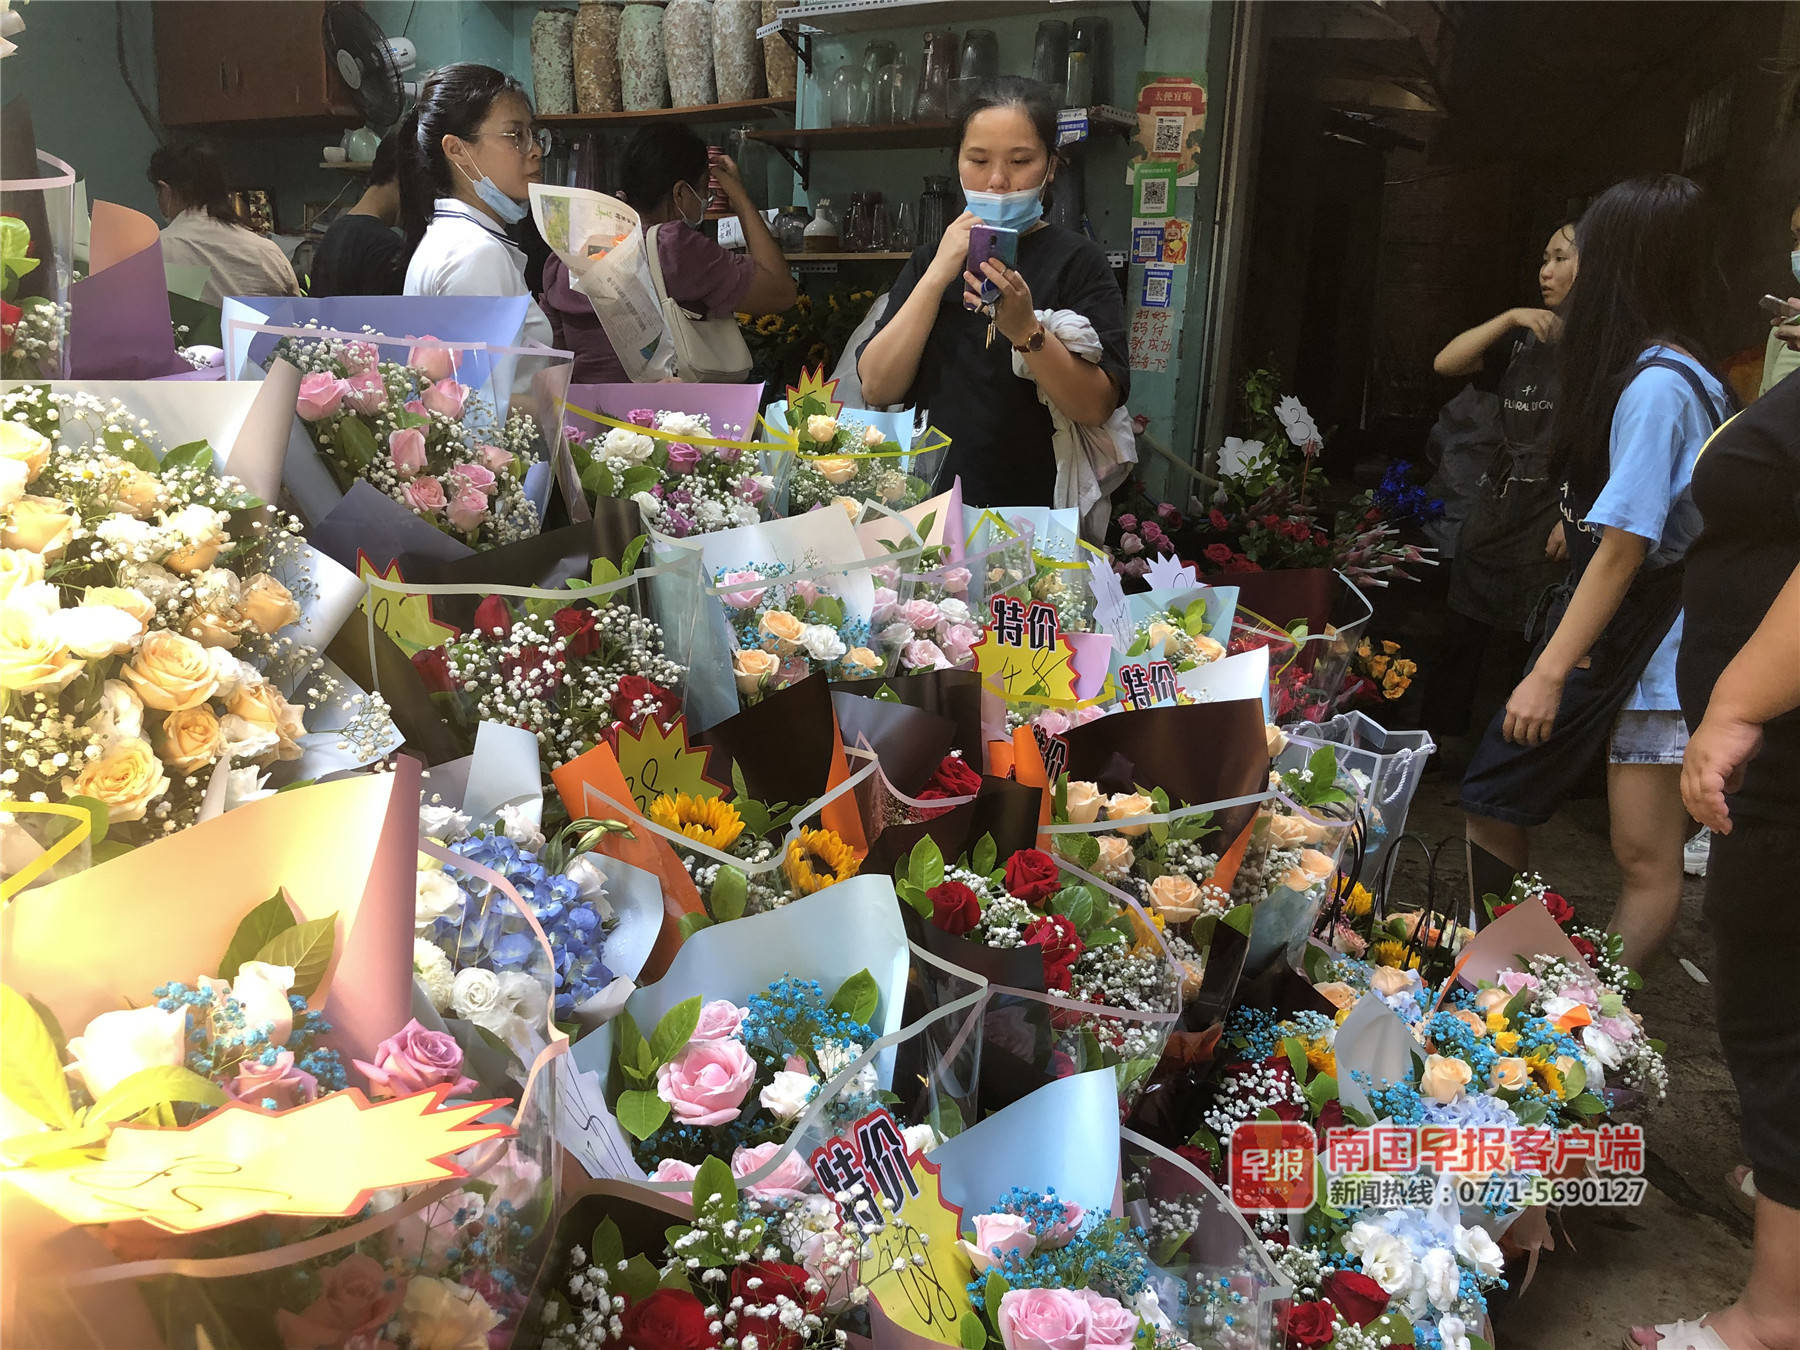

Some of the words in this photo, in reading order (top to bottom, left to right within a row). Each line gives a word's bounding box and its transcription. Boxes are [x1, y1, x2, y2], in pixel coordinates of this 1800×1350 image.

[993, 599, 1057, 652] 特价
[1120, 665, 1178, 710] 特价
[816, 1117, 920, 1244] 特价
